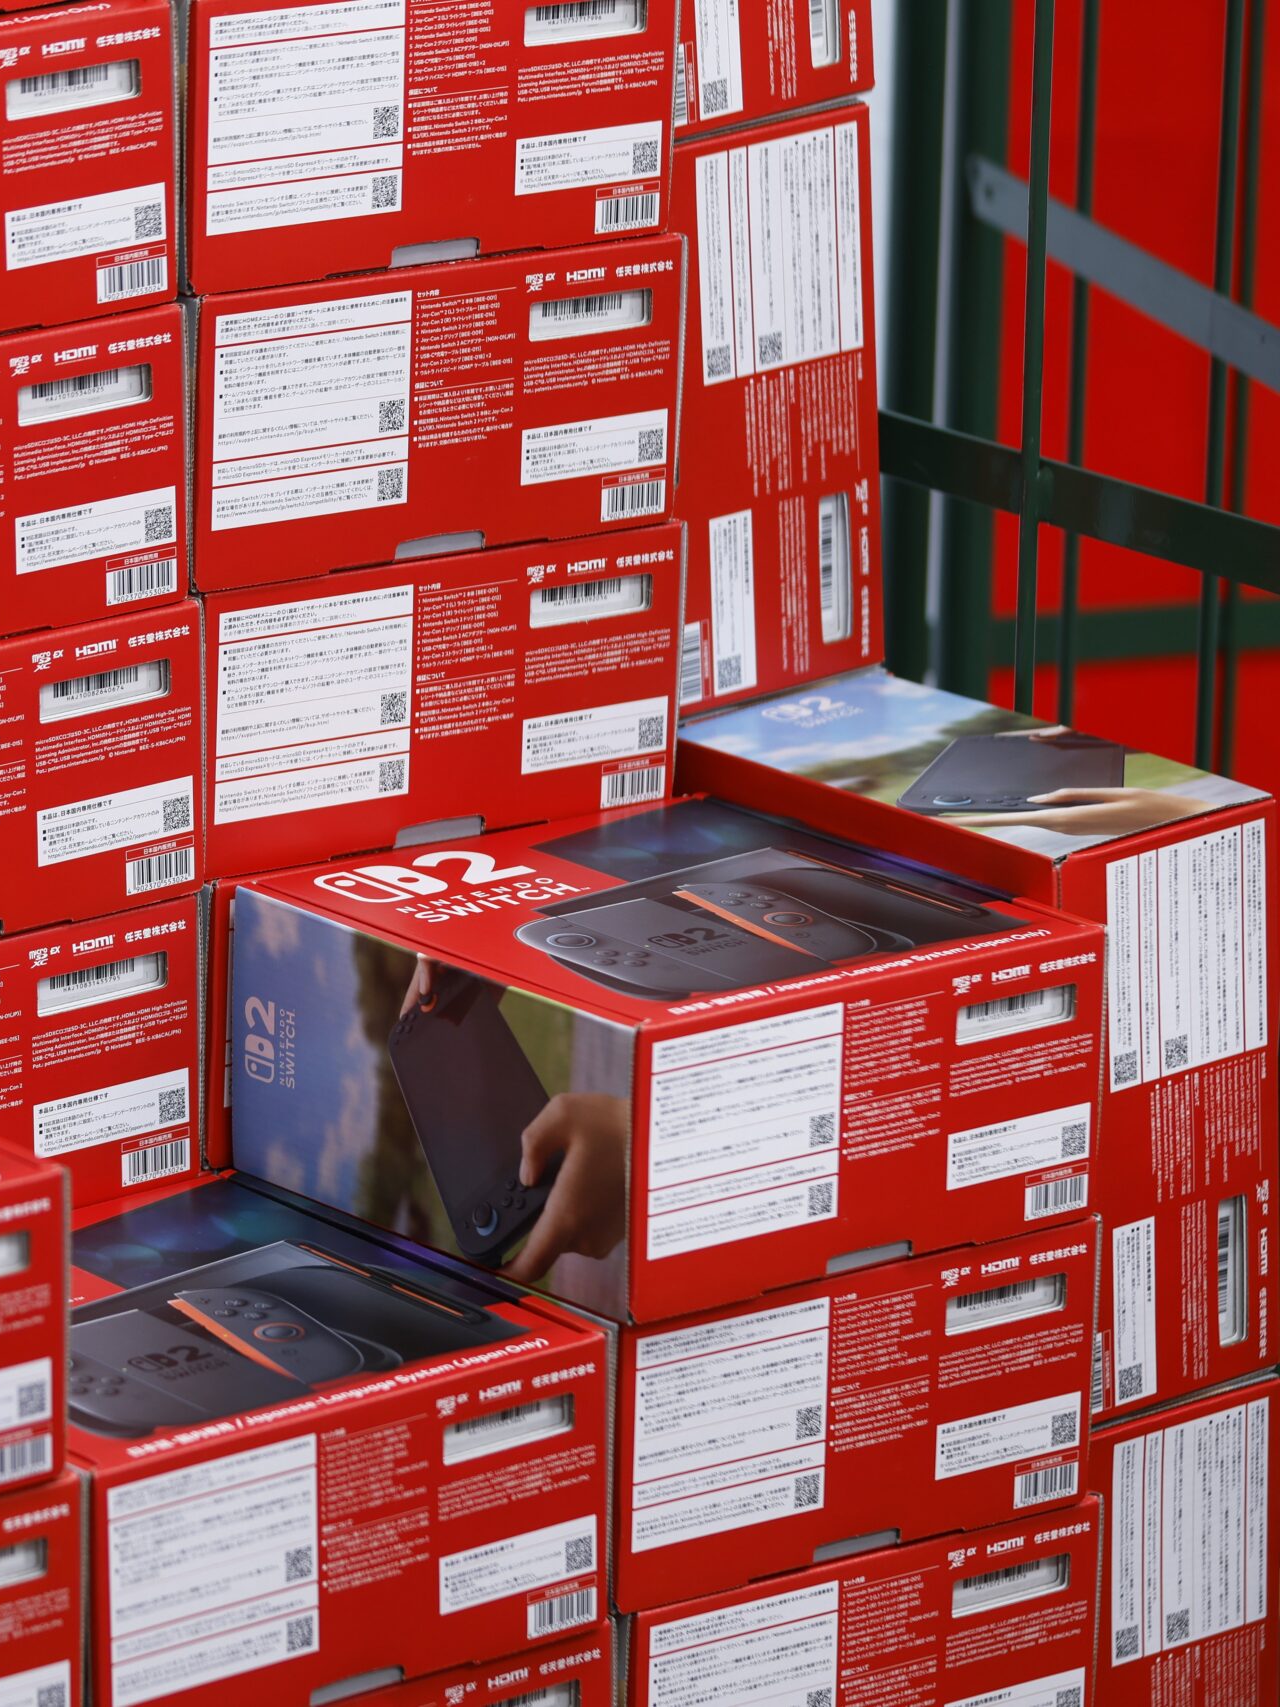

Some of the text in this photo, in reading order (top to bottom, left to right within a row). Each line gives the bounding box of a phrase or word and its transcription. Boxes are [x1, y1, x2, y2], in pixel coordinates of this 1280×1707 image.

[42, 37, 84, 55] HDMI
[566, 267, 604, 281] HDMI
[615, 259, 673, 276] 任天堂株式会社
[108, 290, 132, 300] 902370
[136, 284, 161, 295] 553024
[54, 344, 96, 362] HDMI
[108, 332, 171, 354] 任天堂株式会社
[124, 552, 158, 565] 日本国内販売用
[860, 526, 869, 573] HDMI
[567, 558, 605, 573] HDMI
[117, 592, 142, 603] 902370
[145, 586, 170, 597] 553024
[75, 639, 116, 657] HDMI
[128, 624, 189, 647] 任天堂株式会社
[67, 684, 124, 701] HAJ10082640674
[114, 747, 136, 756] Nintendo
[42, 799, 112, 820] 本品は、日本国内専用仕様です
[143, 841, 176, 855] 日本国内販売用
[412, 851, 536, 885] 2
[136, 881, 160, 892] 902370
[163, 874, 188, 886] 553024
[396, 877, 554, 914] NINTENDO
[72, 934, 113, 953] HDMI
[125, 919, 186, 943] 任天堂株式会社
[683, 927, 730, 941] 2
[911, 947, 966, 962] System
[964, 936, 1012, 951] (Japan
[1010, 929, 1051, 941] Only)
[991, 964, 1028, 982] HDMI
[245, 996, 275, 1036] 2
[286, 1010, 296, 1089] SWITCH
[39, 1092, 108, 1114] 本品は、日本国内専用仕様です
[139, 1133, 172, 1146] 日本国内販売用
[132, 1172, 156, 1183] 902370
[159, 1165, 183, 1177] 553024
[1260, 1227, 1268, 1274] HDMI
[981, 1256, 1019, 1274] HDMI
[167, 1345, 214, 1362] 2
[394, 1363, 455, 1383] System
[453, 1349, 507, 1368] (Japan
[504, 1337, 549, 1354] Only)
[479, 1379, 520, 1400] HDMI
[986, 1536, 1024, 1554] HDMI
[486, 1668, 528, 1687] HDMI
